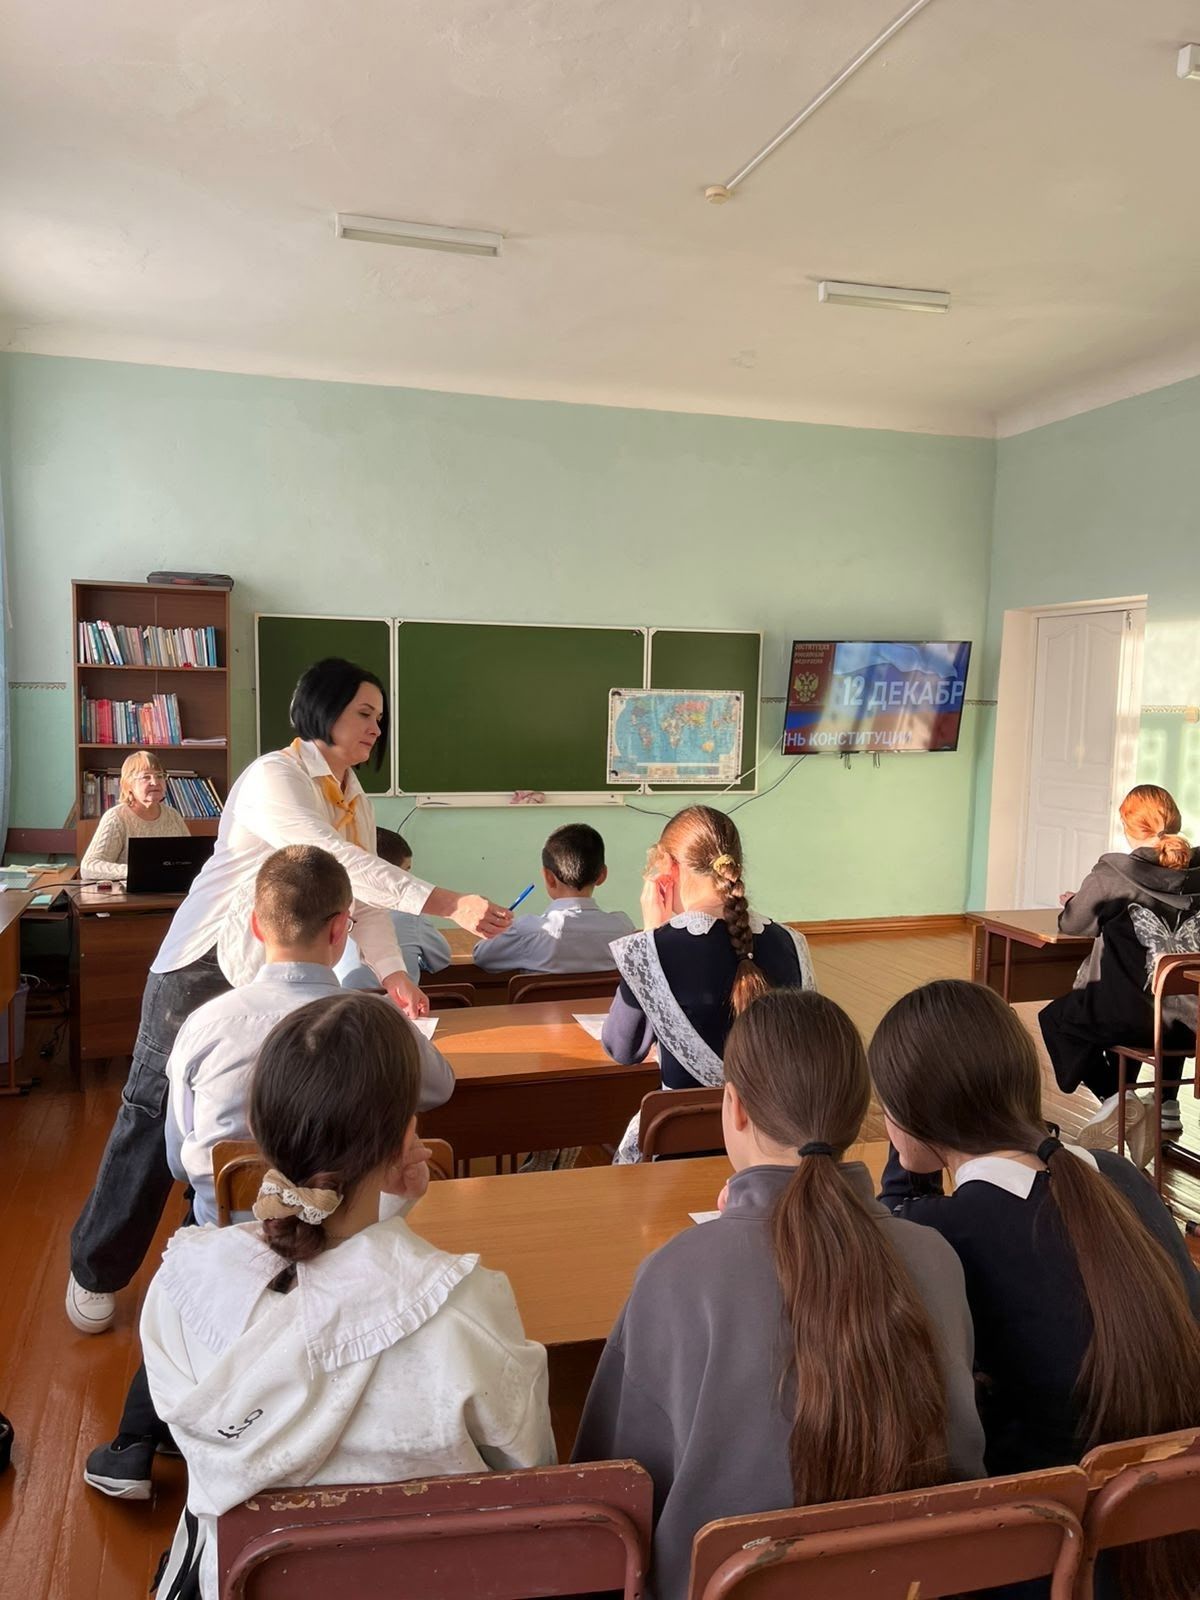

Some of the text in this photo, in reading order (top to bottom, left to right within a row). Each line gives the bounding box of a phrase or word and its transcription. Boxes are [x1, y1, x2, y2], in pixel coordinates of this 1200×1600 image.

[843, 676, 866, 706] 12
[785, 731, 912, 747] НЬ КОНСТИТУЦИИ
